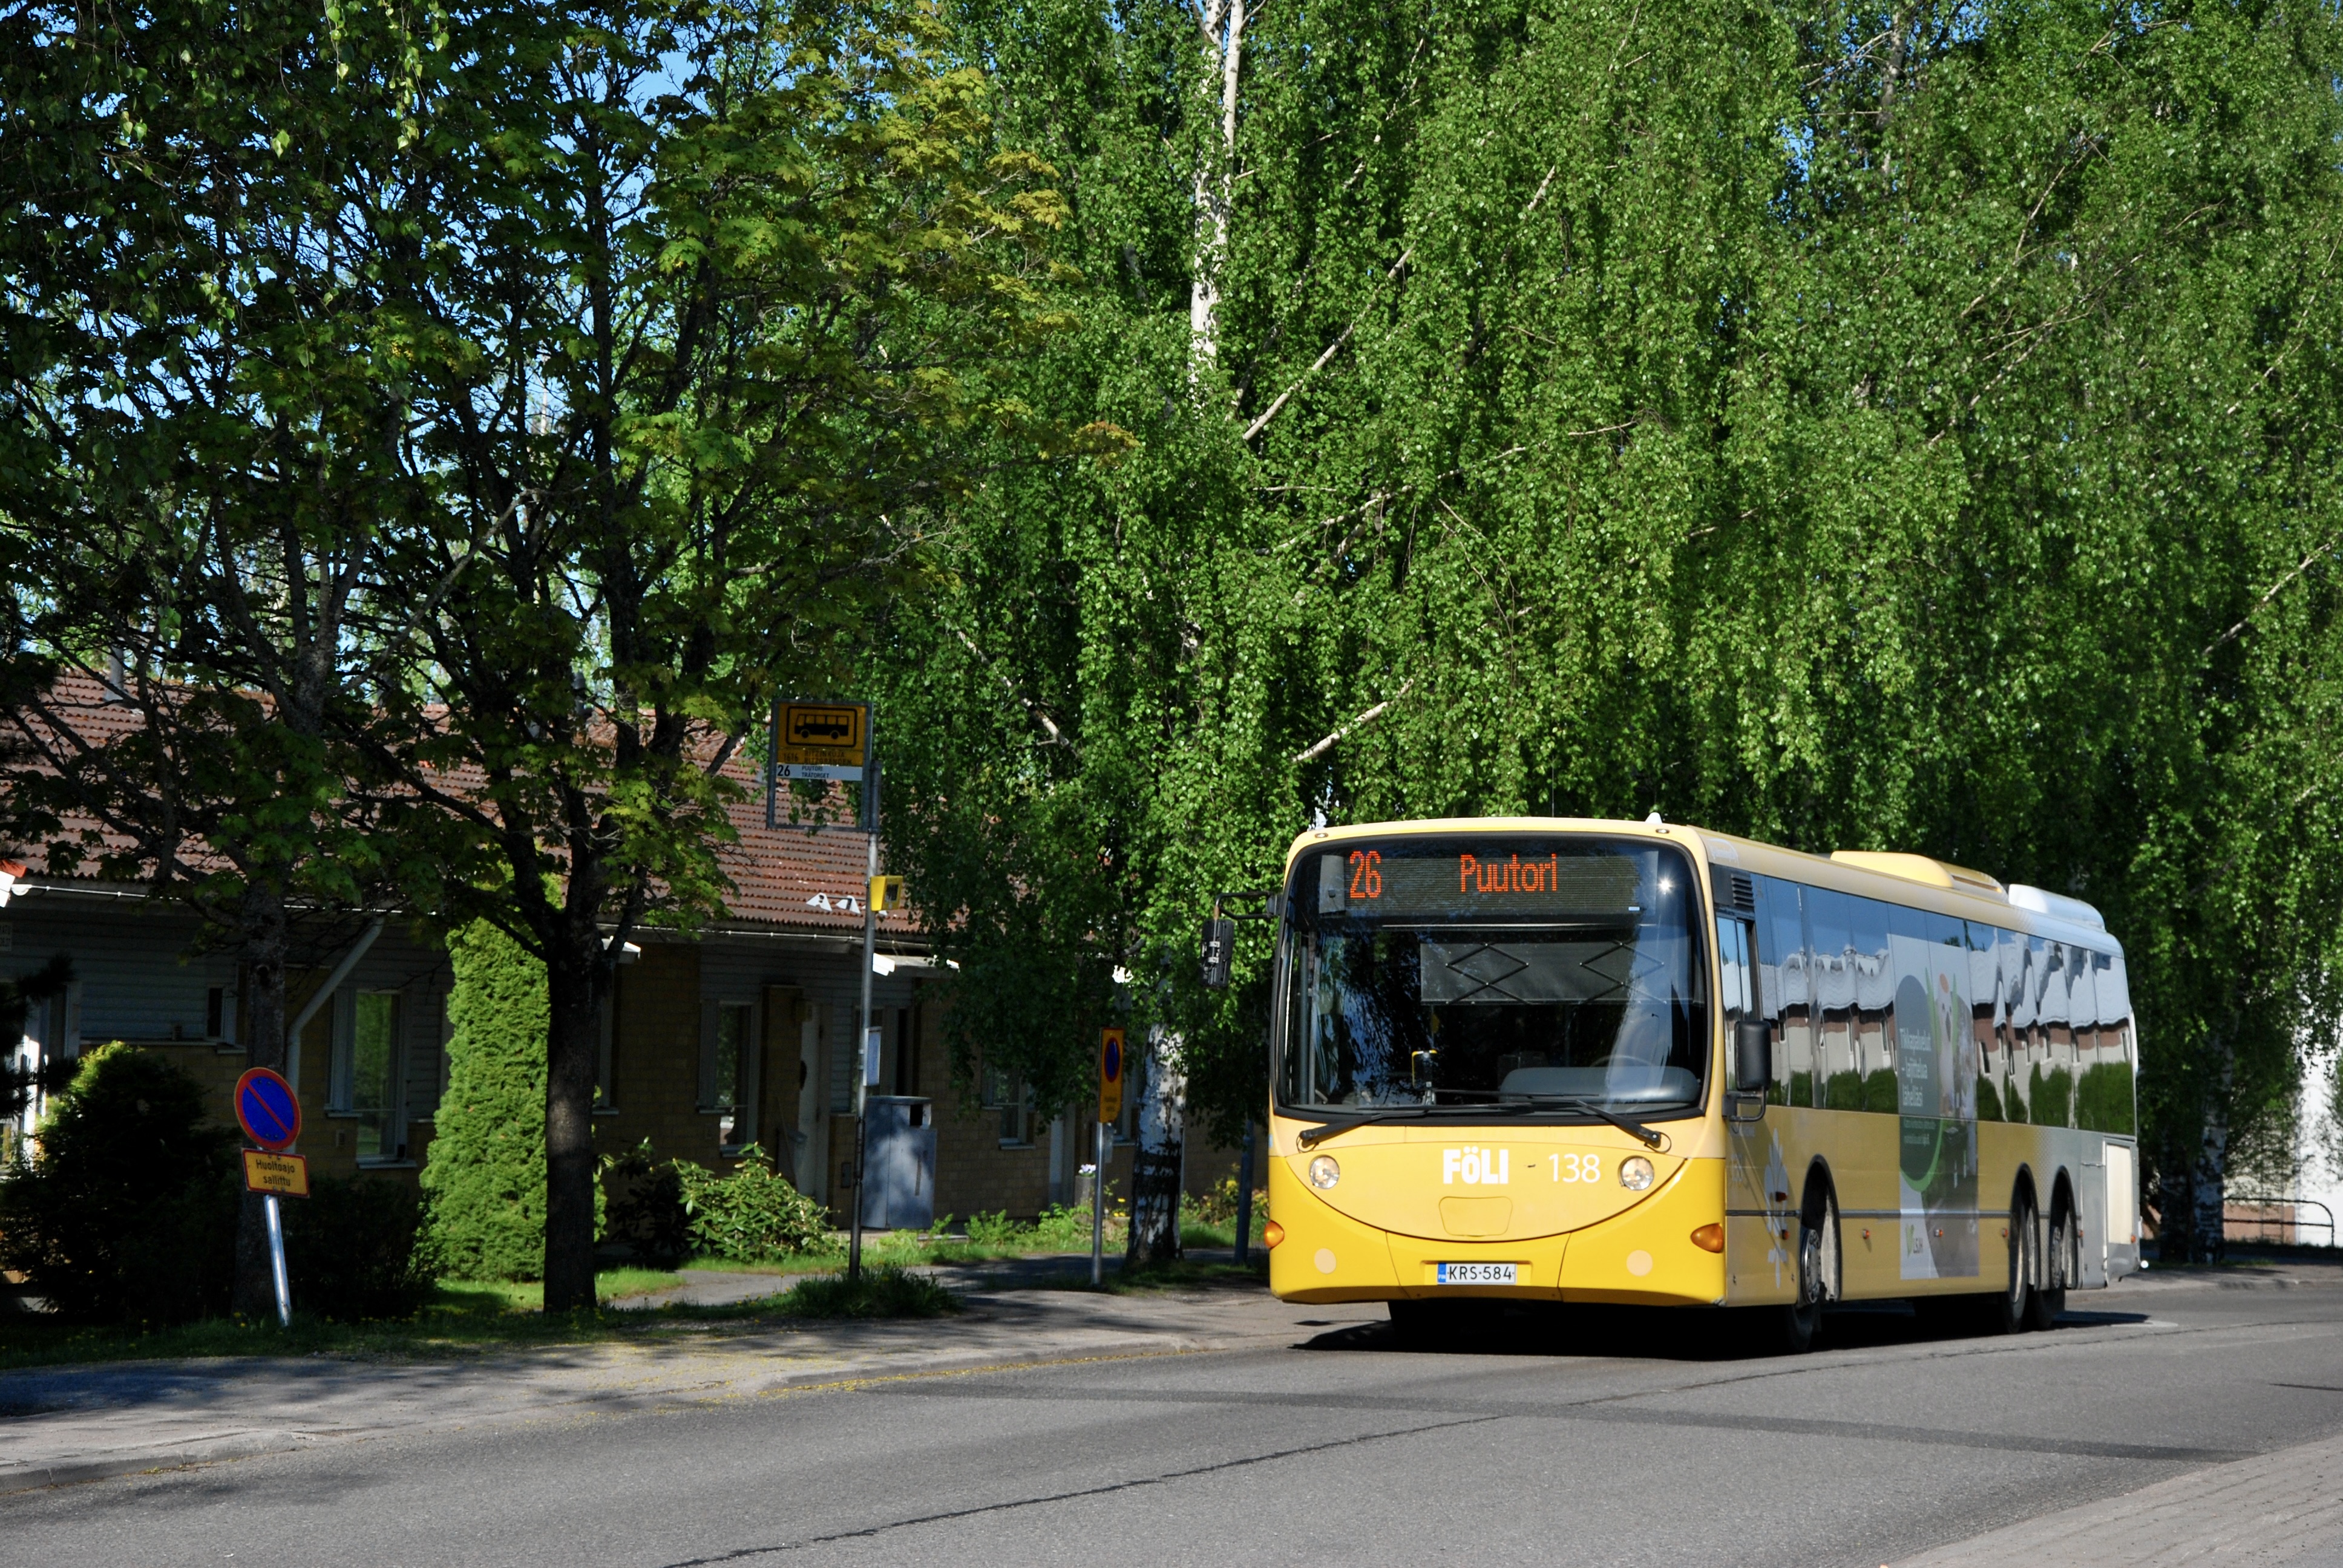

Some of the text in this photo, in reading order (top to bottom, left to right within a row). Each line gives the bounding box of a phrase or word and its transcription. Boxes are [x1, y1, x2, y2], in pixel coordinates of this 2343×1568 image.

[778, 765, 790, 777] 26
[1349, 851, 1558, 898] 26 Puutori
[256, 1159, 295, 1174] Huoltoajo
[1548, 1154, 1601, 1183] 138
[263, 1175, 290, 1186] sallittu
[1449, 1266, 1512, 1280] KRS-584
